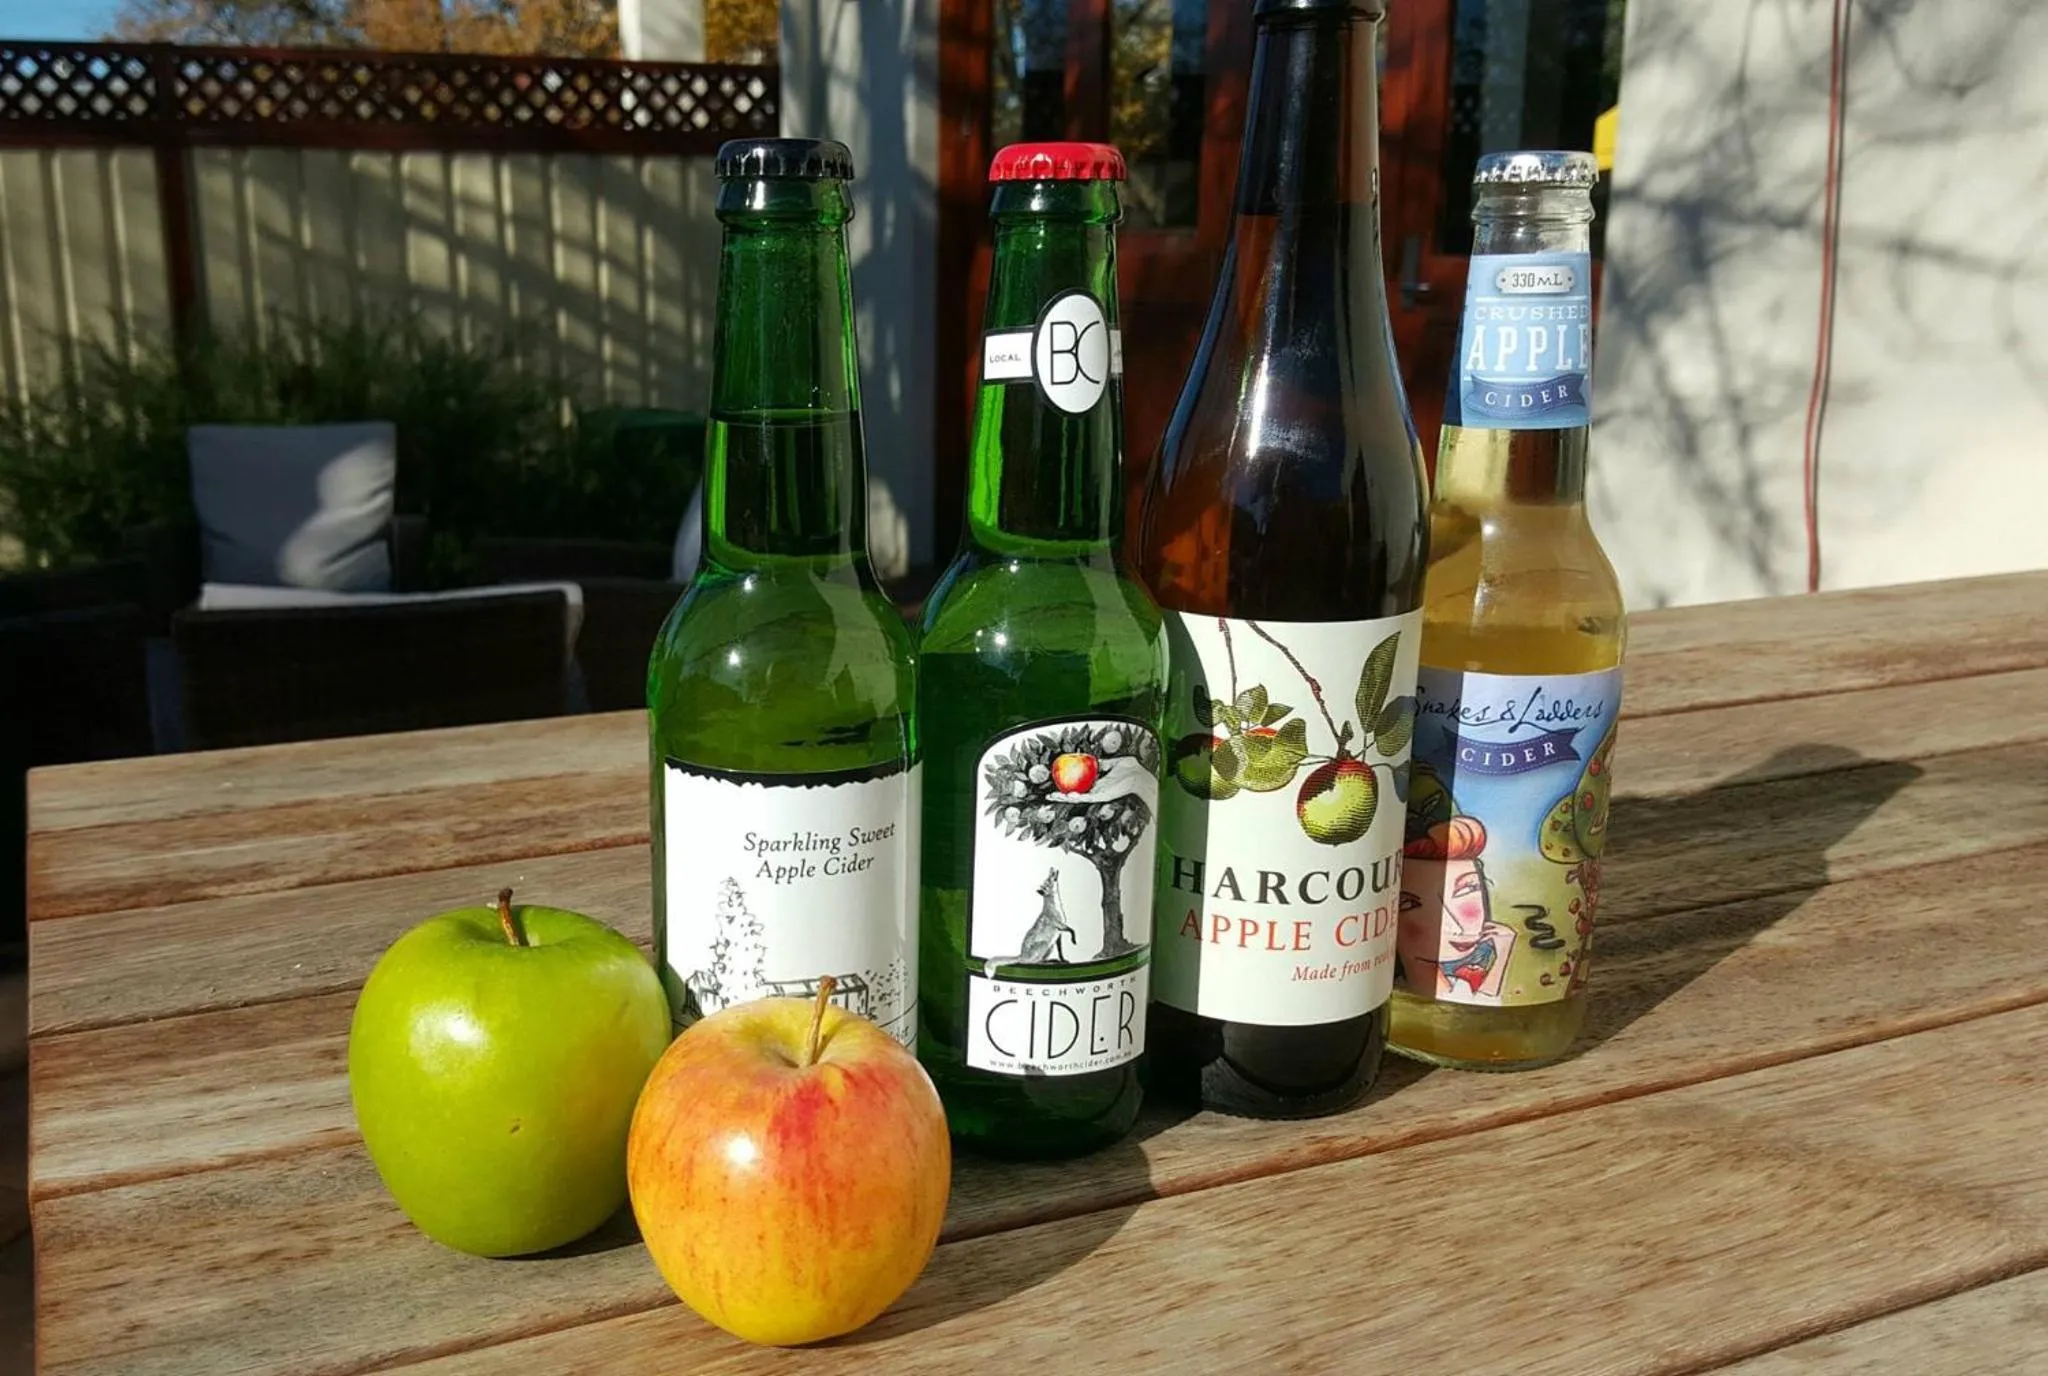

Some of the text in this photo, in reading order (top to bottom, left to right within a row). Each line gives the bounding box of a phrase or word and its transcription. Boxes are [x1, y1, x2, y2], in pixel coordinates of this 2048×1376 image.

[1474, 304, 1588, 321] CRUSHED
[1050, 320, 1100, 385] BC
[1465, 324, 1588, 371] APPLE
[1484, 385, 1569, 408] CIDER
[1500, 700, 1516, 721] &
[1508, 686, 1605, 734] Ladders
[1461, 742, 1556, 768] CIDER
[743, 822, 896, 858] Sparkling Sweet
[755, 853, 875, 885] Apple Cider
[1179, 908, 1313, 952] APPLE
[993, 977, 1137, 996] BEECHWORTH
[1291, 963, 1338, 982] Made
[1338, 960, 1371, 982] from
[985, 991, 1136, 1060] CIDER
